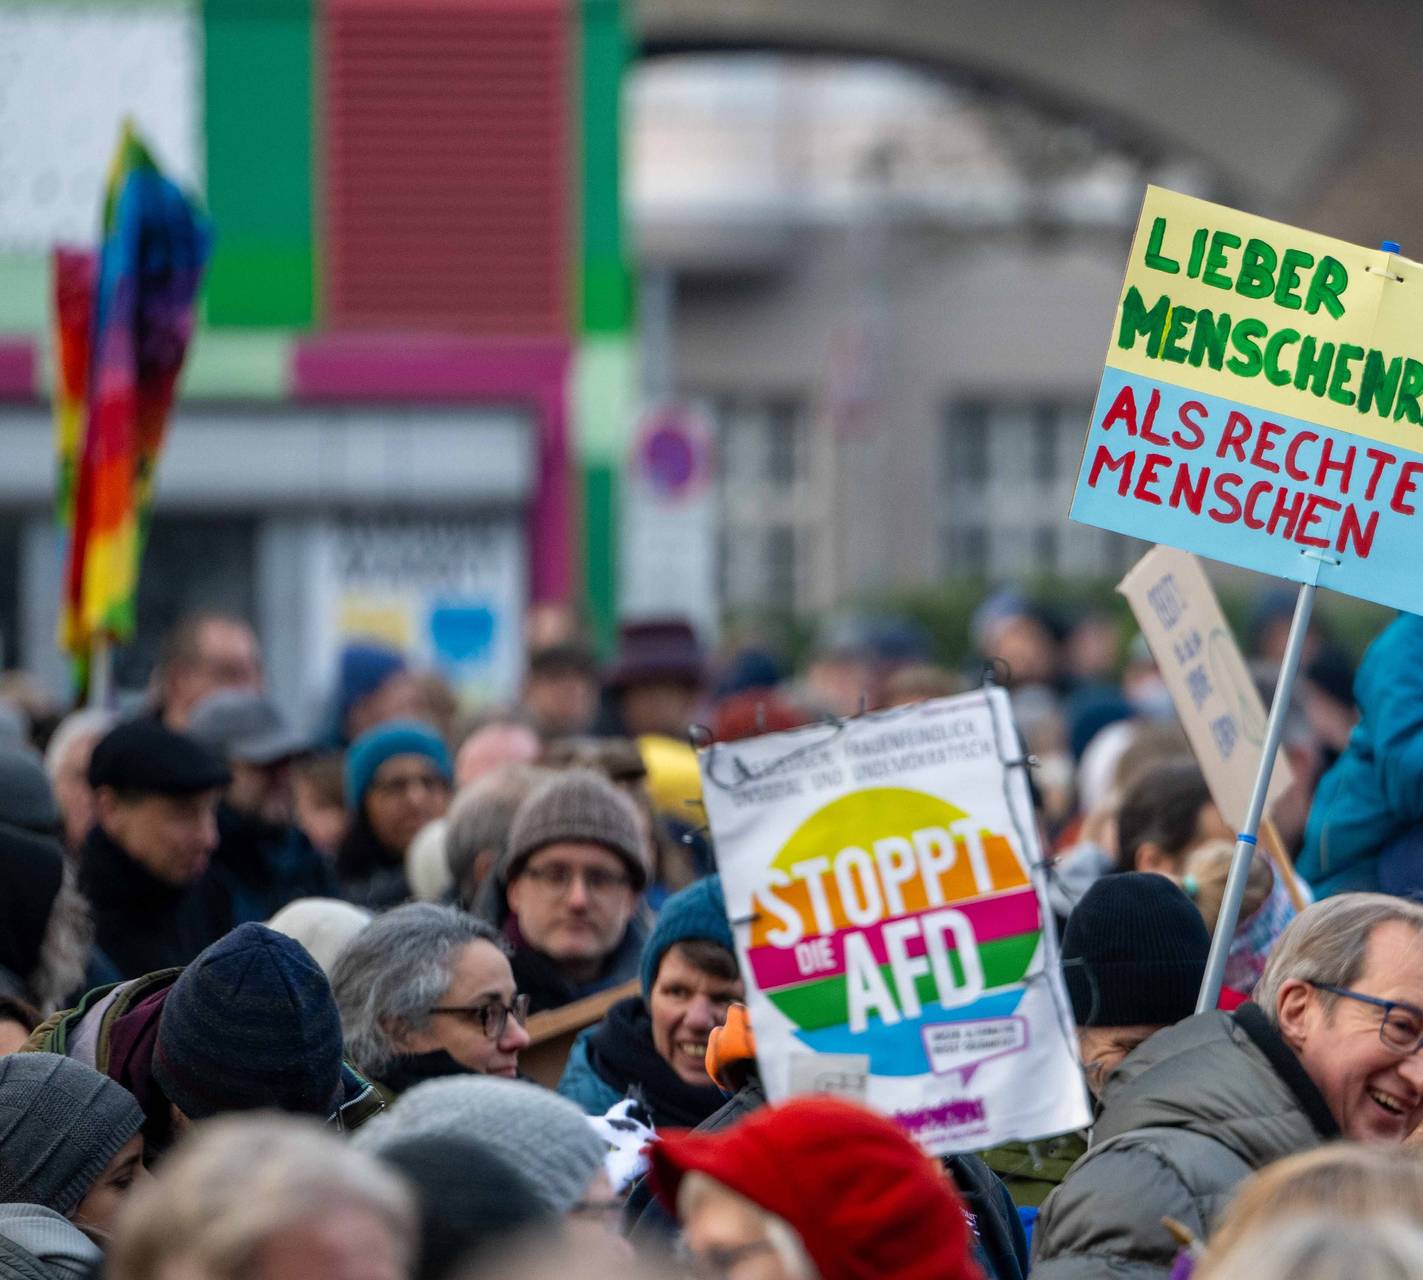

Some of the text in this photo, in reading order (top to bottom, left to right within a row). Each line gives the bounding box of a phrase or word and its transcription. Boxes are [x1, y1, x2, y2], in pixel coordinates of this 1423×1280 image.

[1144, 216, 1348, 320] LIEBER
[1101, 385, 1210, 451] ALS
[1088, 445, 1380, 559] MENSCHEN
[755, 817, 995, 949] STOPPT
[795, 908, 985, 1034] DIE AFD
